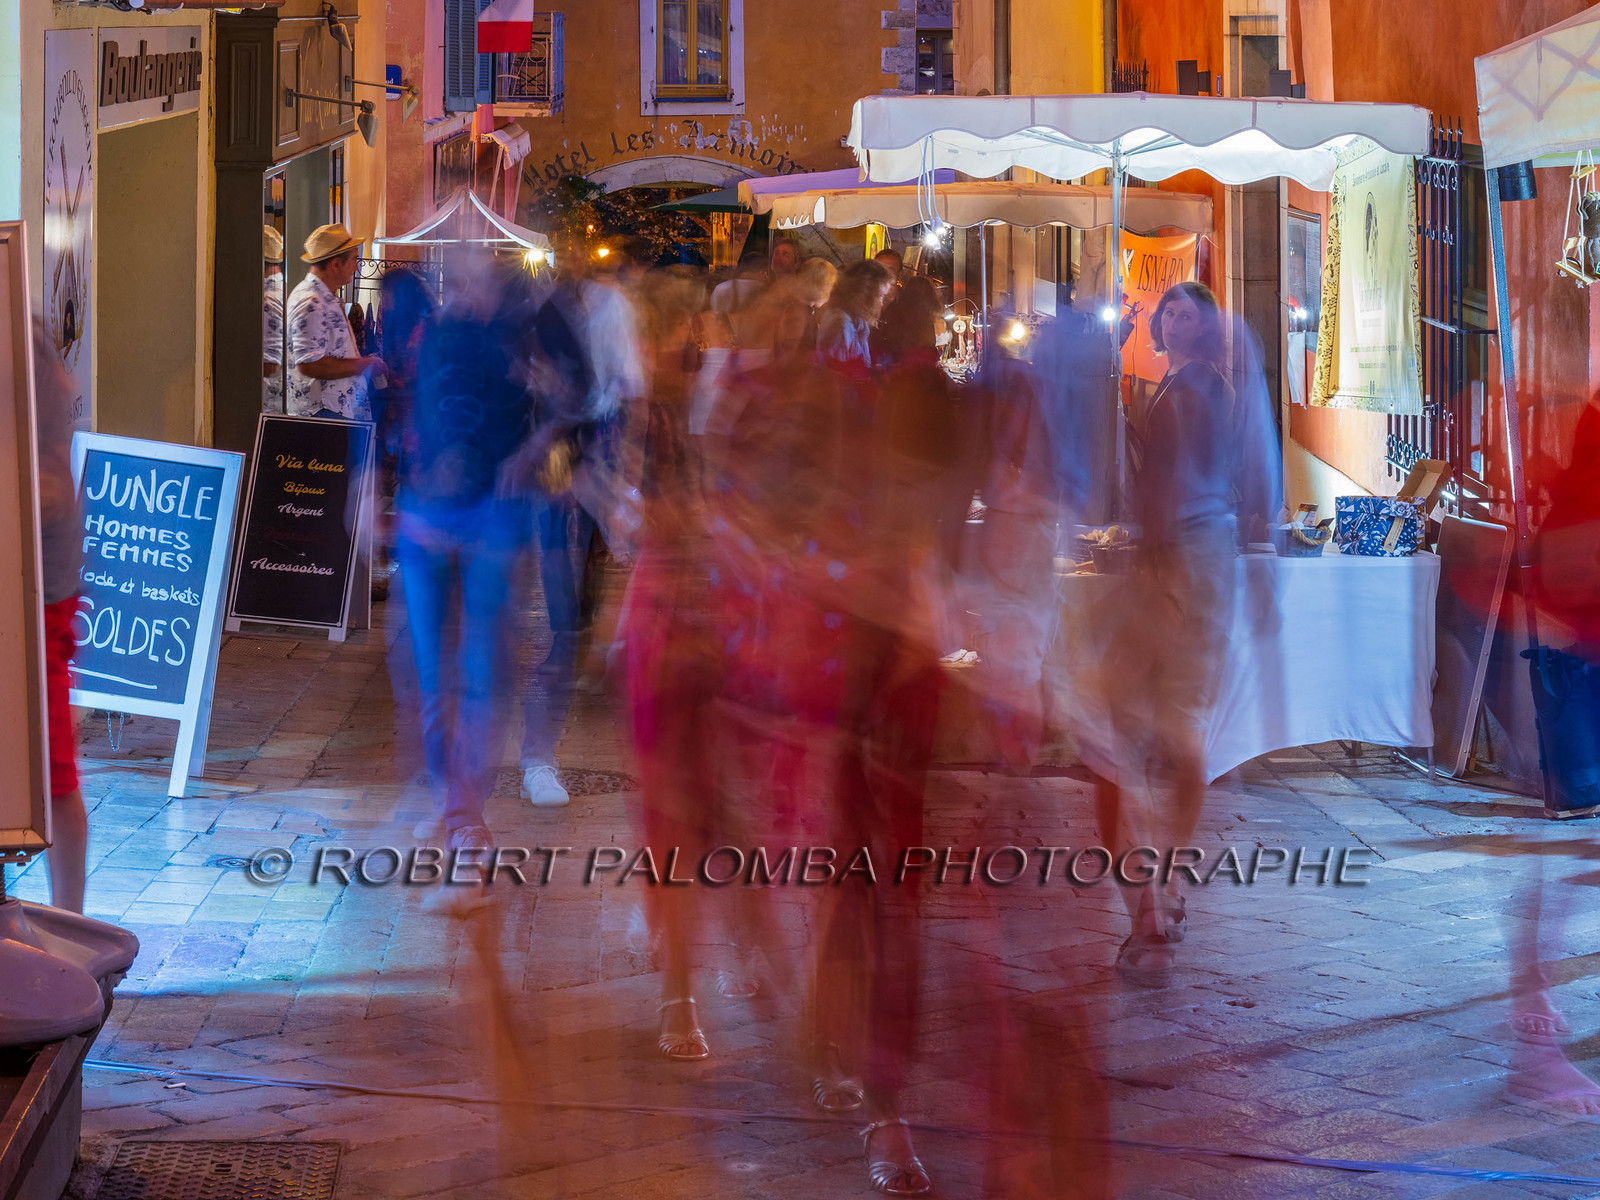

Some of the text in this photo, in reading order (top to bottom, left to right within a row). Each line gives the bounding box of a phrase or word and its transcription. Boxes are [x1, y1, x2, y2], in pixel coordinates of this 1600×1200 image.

[99, 36, 202, 112] Boulangerie
[522, 141, 596, 196] Hôtel
[1137, 254, 1184, 294] ISNARD
[276, 454, 345, 473] Via luna
[86, 461, 214, 521] JUNGLE
[283, 481, 326, 496] Bijoux
[277, 502, 324, 518] Argent
[84, 514, 191, 551] HOMMES
[82, 536, 193, 572] FEMMES
[250, 557, 335, 576] Accessoires
[141, 580, 201, 607] baskets
[72, 596, 191, 667] SOLDES
